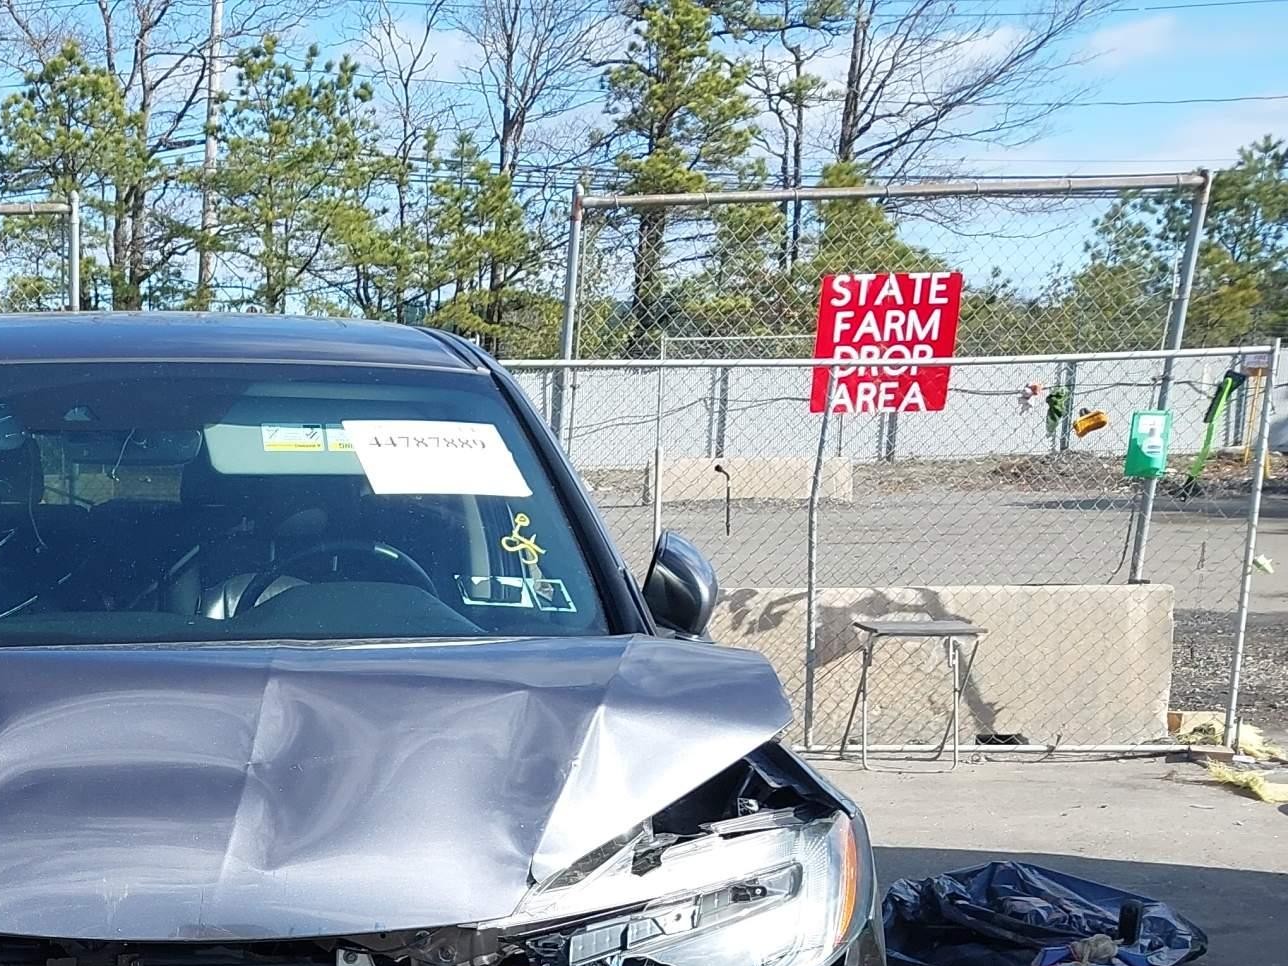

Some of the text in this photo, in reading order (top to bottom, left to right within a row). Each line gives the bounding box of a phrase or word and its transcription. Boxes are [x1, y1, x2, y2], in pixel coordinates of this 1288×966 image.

[830, 272, 951, 307] STATE
[833, 309, 942, 343] FARM
[833, 344, 934, 378] DROP
[829, 381, 928, 414] AREA
[368, 435, 487, 449] 44787889
